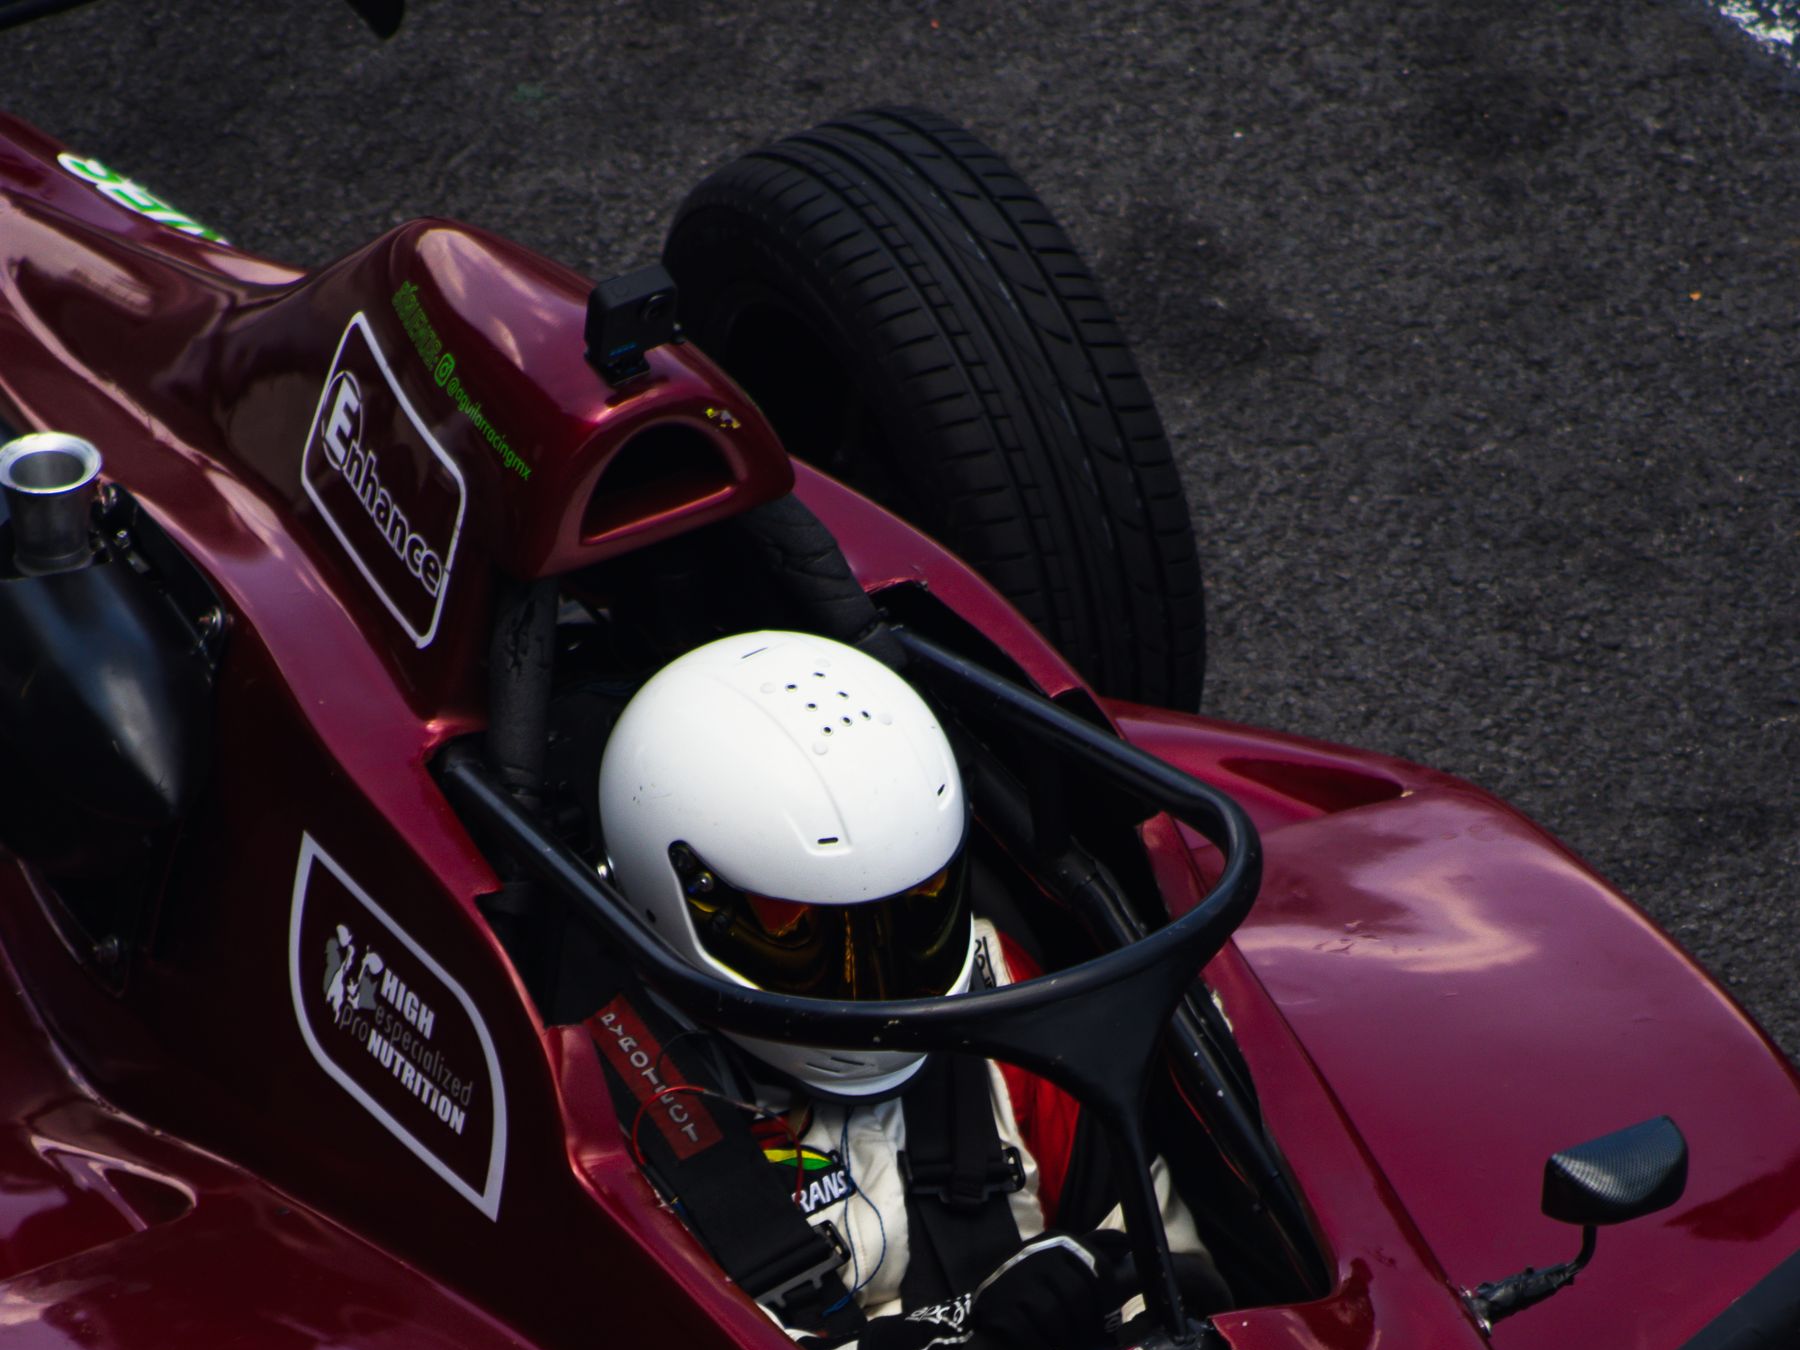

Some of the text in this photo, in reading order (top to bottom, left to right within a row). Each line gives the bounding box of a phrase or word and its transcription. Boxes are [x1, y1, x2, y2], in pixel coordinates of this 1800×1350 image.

[323, 374, 443, 599] Enhance
[374, 1004, 474, 1107] especialized
[380, 967, 435, 1041] HIGH
[600, 1012, 699, 1143] PYROTECT
